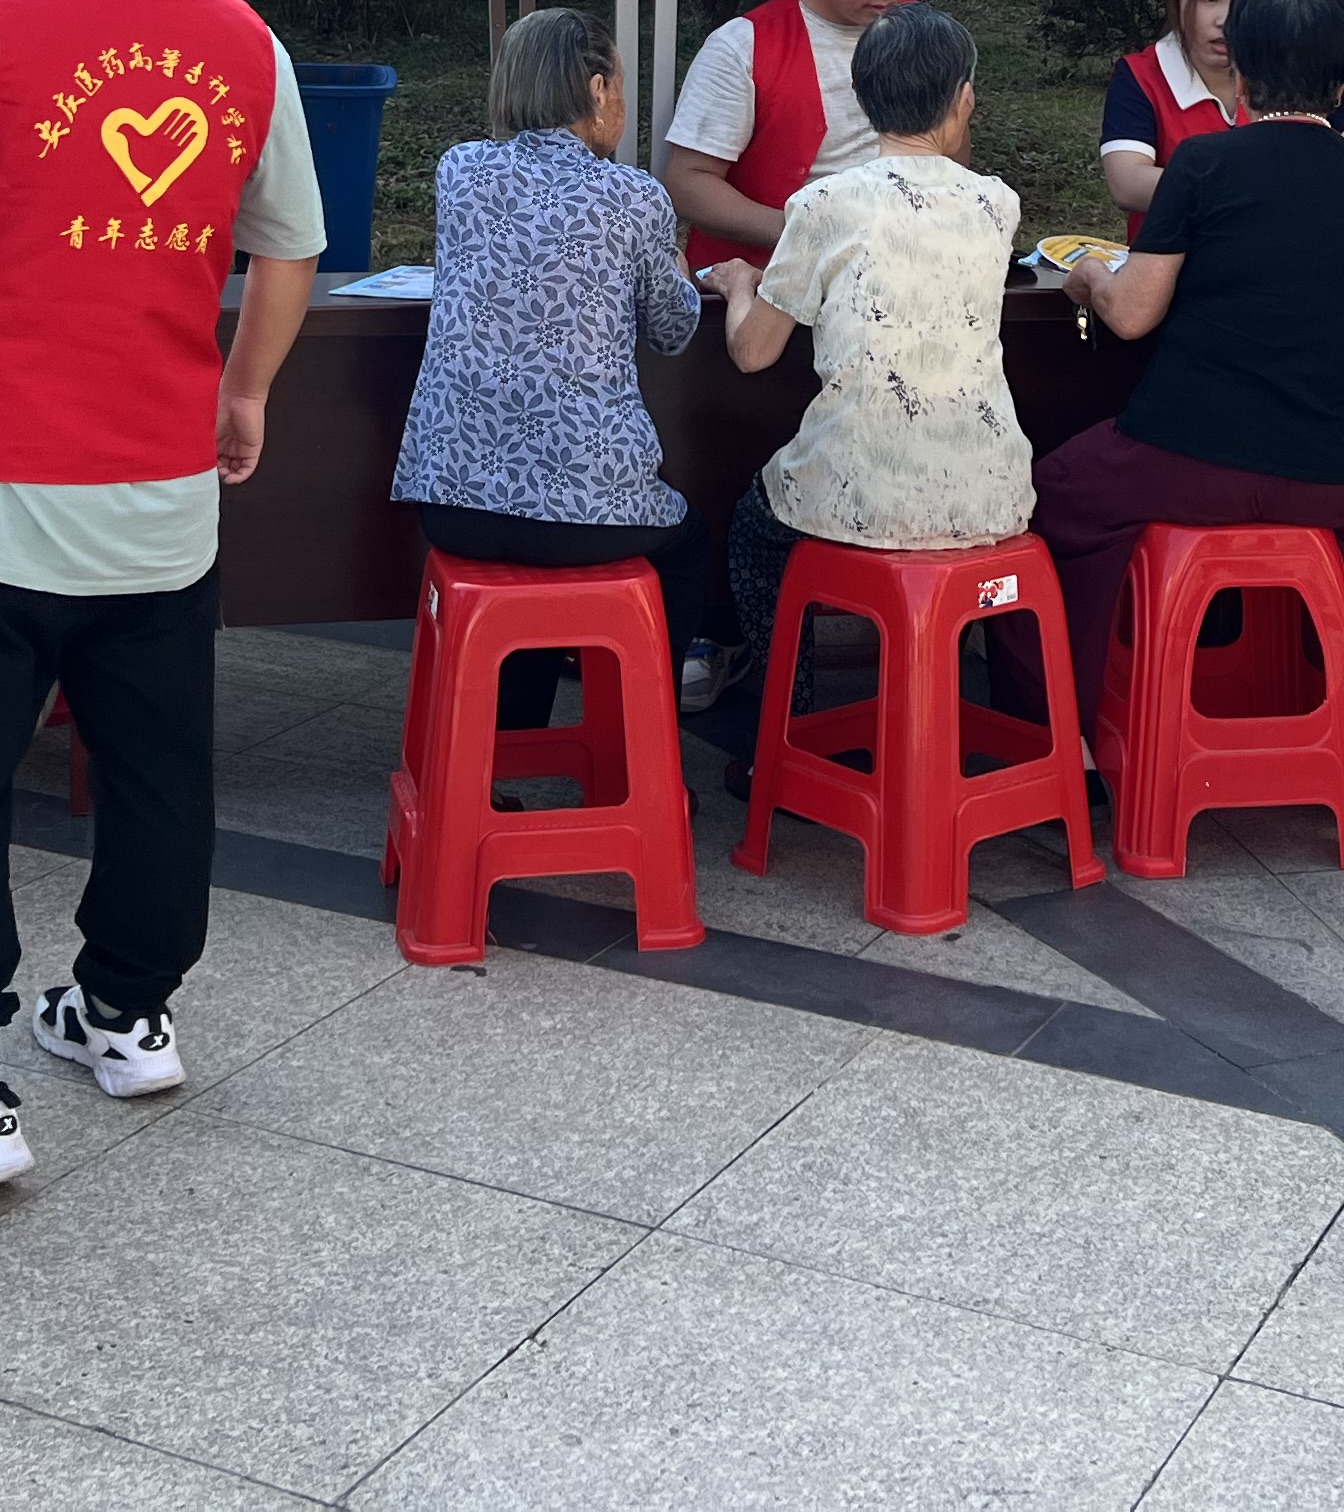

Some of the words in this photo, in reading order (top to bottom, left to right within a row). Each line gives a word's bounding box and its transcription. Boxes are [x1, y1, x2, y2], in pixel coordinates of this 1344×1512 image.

[60, 215, 216, 254] 青年志愿者
